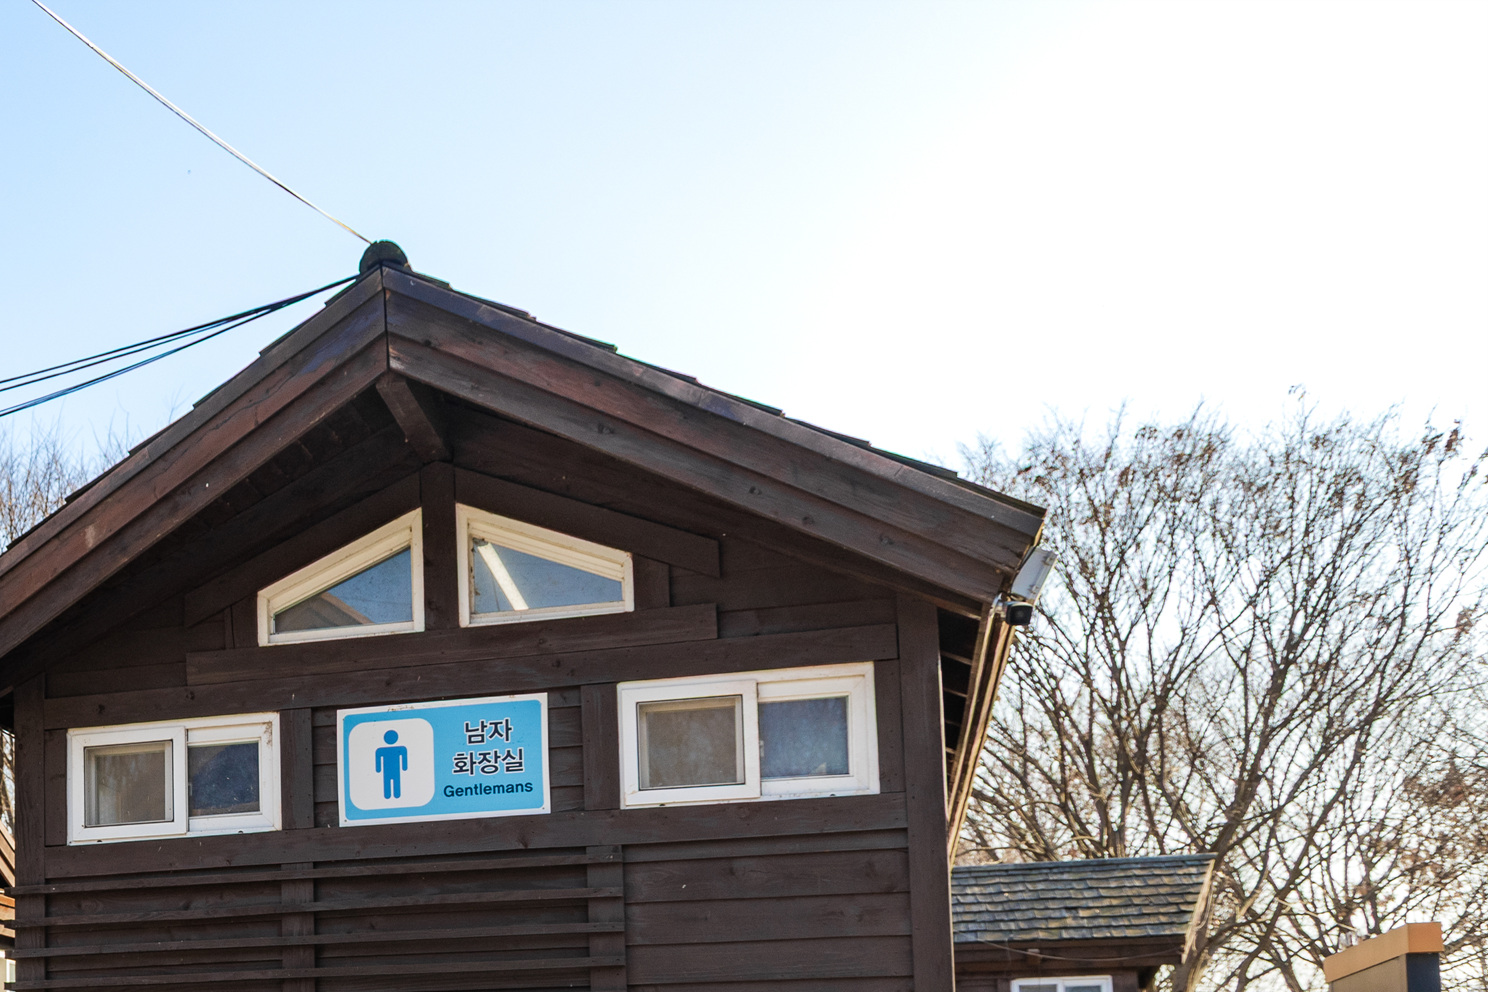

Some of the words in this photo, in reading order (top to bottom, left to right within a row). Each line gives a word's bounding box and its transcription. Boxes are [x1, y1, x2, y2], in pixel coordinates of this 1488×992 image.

[464, 717, 513, 745] 남자
[452, 748, 525, 776] 화장실
[443, 782, 534, 798] Gentlemans
